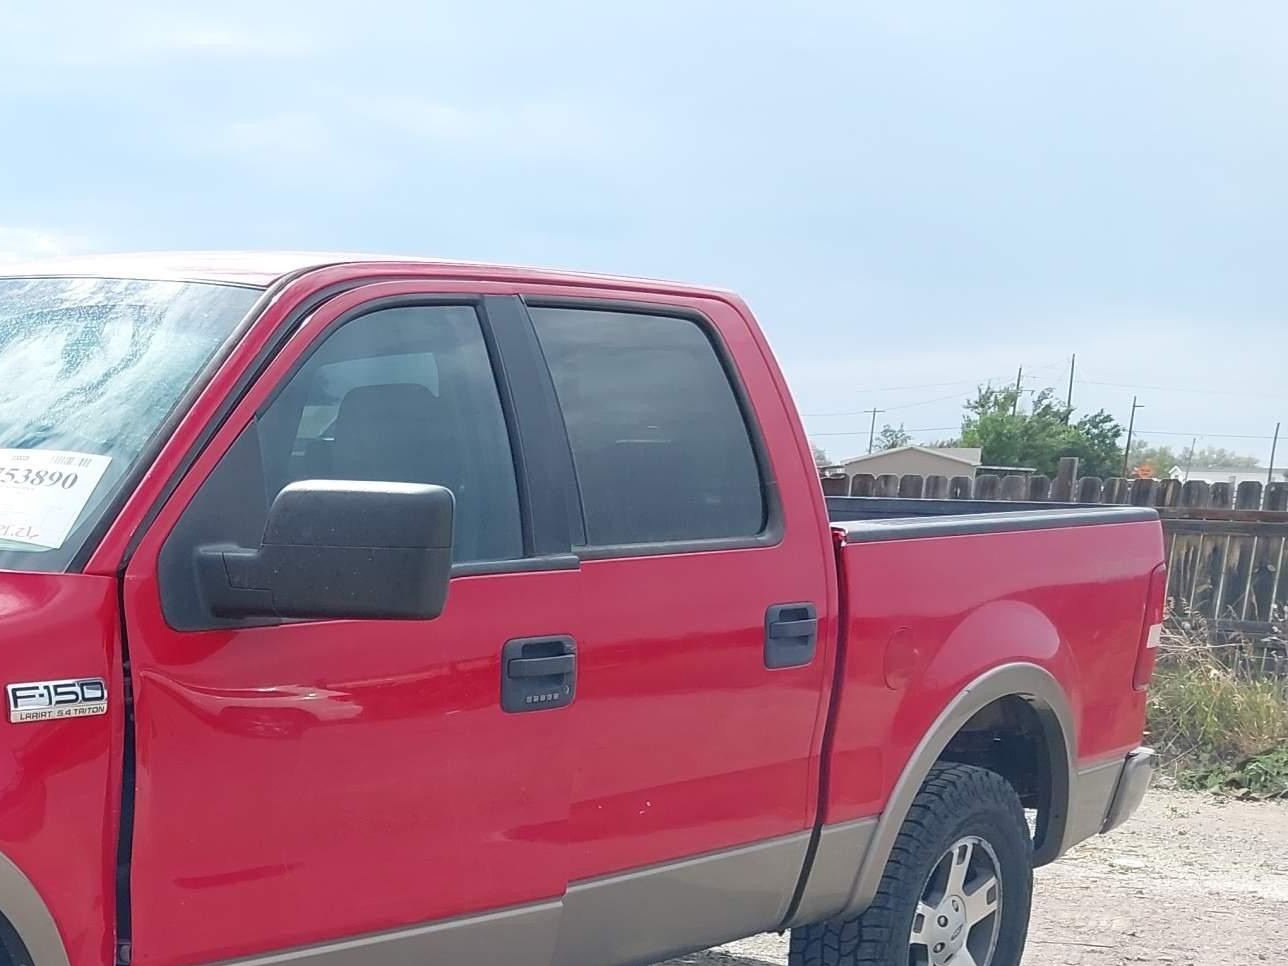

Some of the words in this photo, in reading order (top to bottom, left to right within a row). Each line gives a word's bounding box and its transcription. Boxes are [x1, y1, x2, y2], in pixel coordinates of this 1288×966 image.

[11, 681, 105, 708] F-150
[20, 711, 53, 720] LARIAT
[74, 706, 105, 714] TRITON
